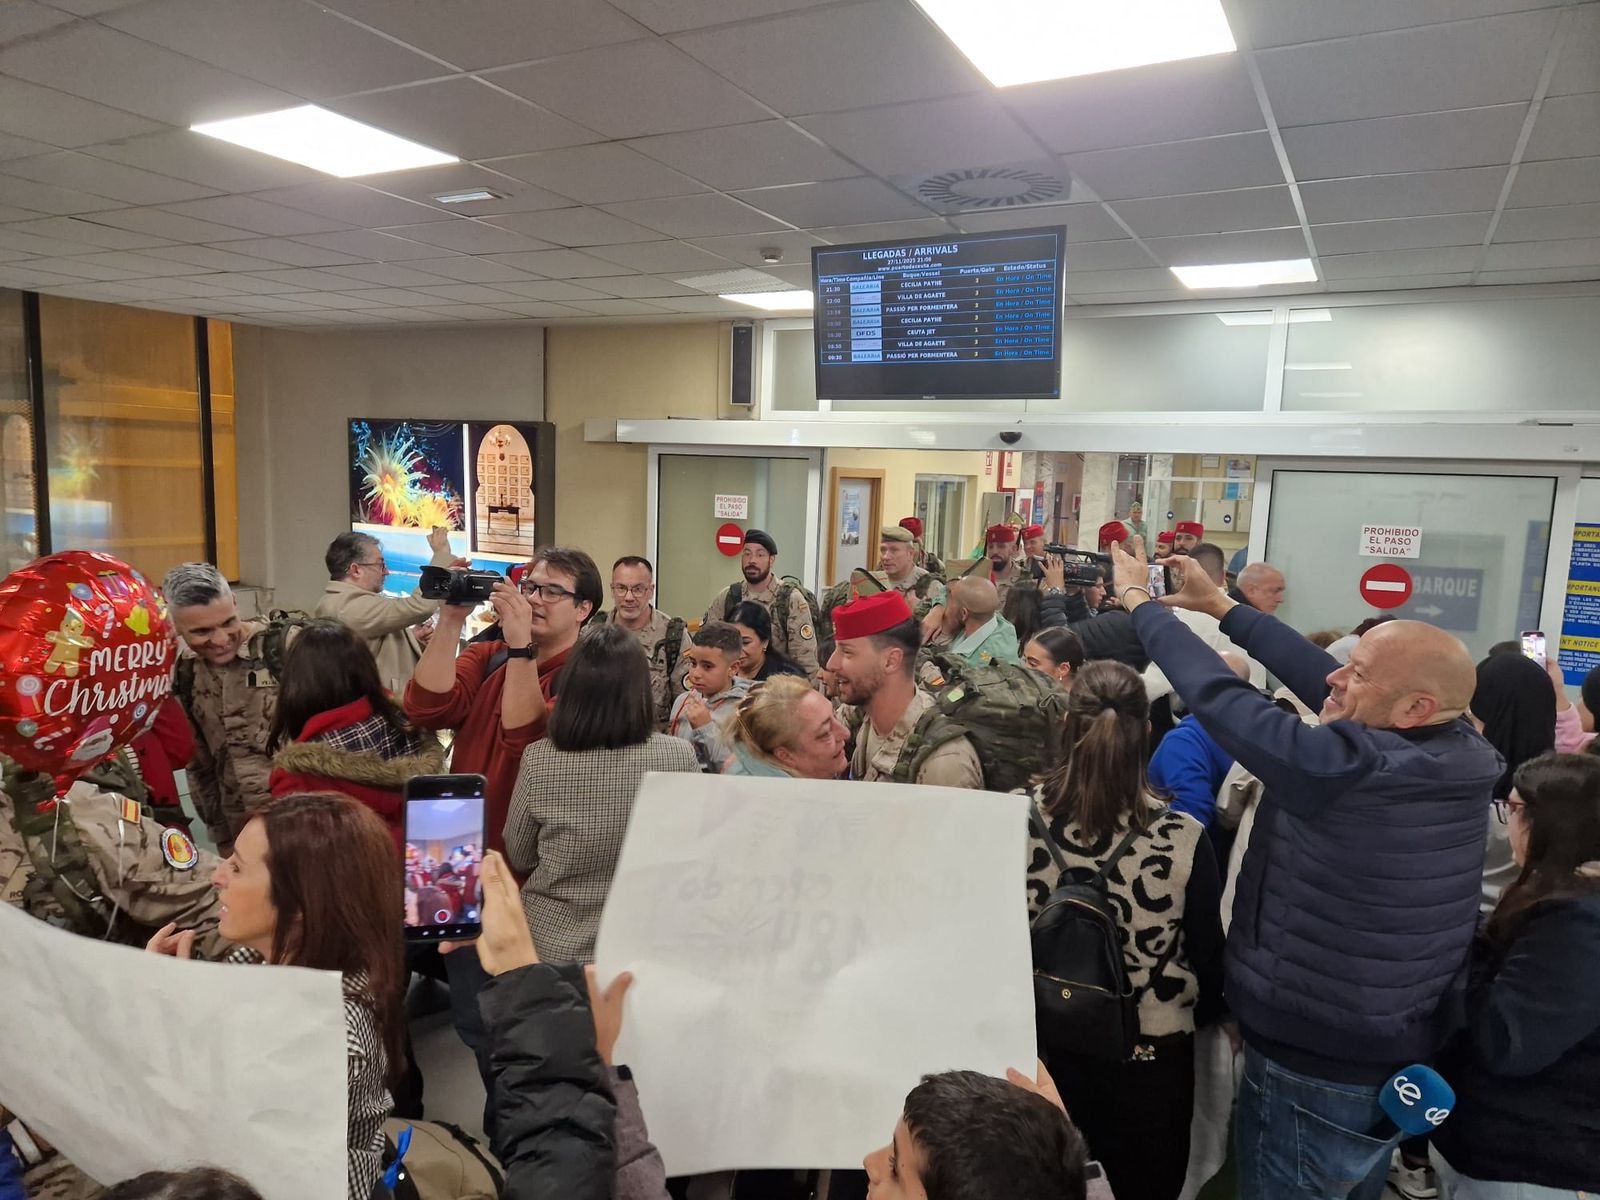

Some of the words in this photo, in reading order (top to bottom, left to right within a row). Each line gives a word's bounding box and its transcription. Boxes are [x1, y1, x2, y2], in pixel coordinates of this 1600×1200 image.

[862, 249, 906, 260] LLEGADAS
[914, 245, 958, 256] ARRIVALS
[1004, 263, 1046, 272] Estado/Status
[1364, 527, 1419, 537] PROHIBIDO
[1369, 536, 1381, 544] EL
[1384, 536, 1411, 546] PASO
[1573, 640, 1598, 648] NOTICE
[89, 639, 169, 676] MERRY
[43, 671, 173, 717] Christma
